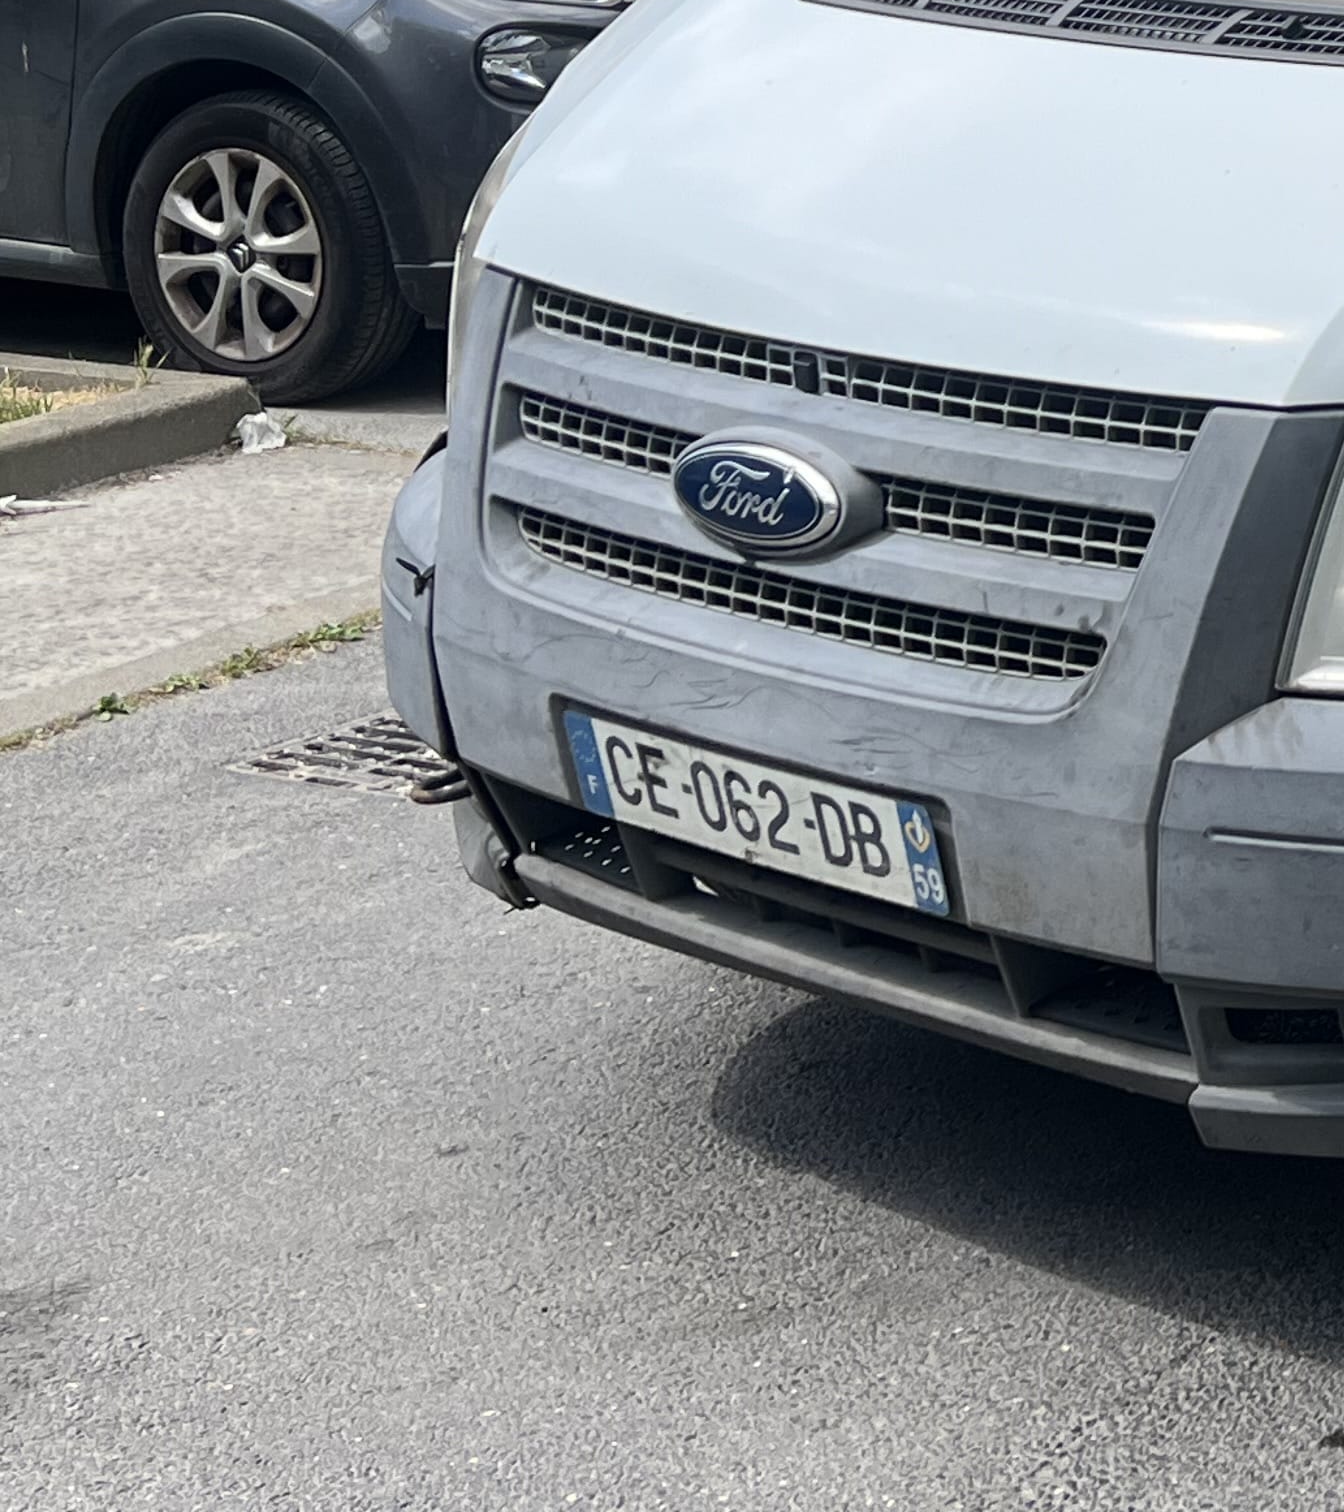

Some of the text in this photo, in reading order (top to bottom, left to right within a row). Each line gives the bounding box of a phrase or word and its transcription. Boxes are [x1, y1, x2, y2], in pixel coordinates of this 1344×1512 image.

[699, 460, 791, 526] Ford
[586, 774, 599, 795] F
[604, 735, 891, 877] CE-062-DB
[912, 863, 944, 904] 59
